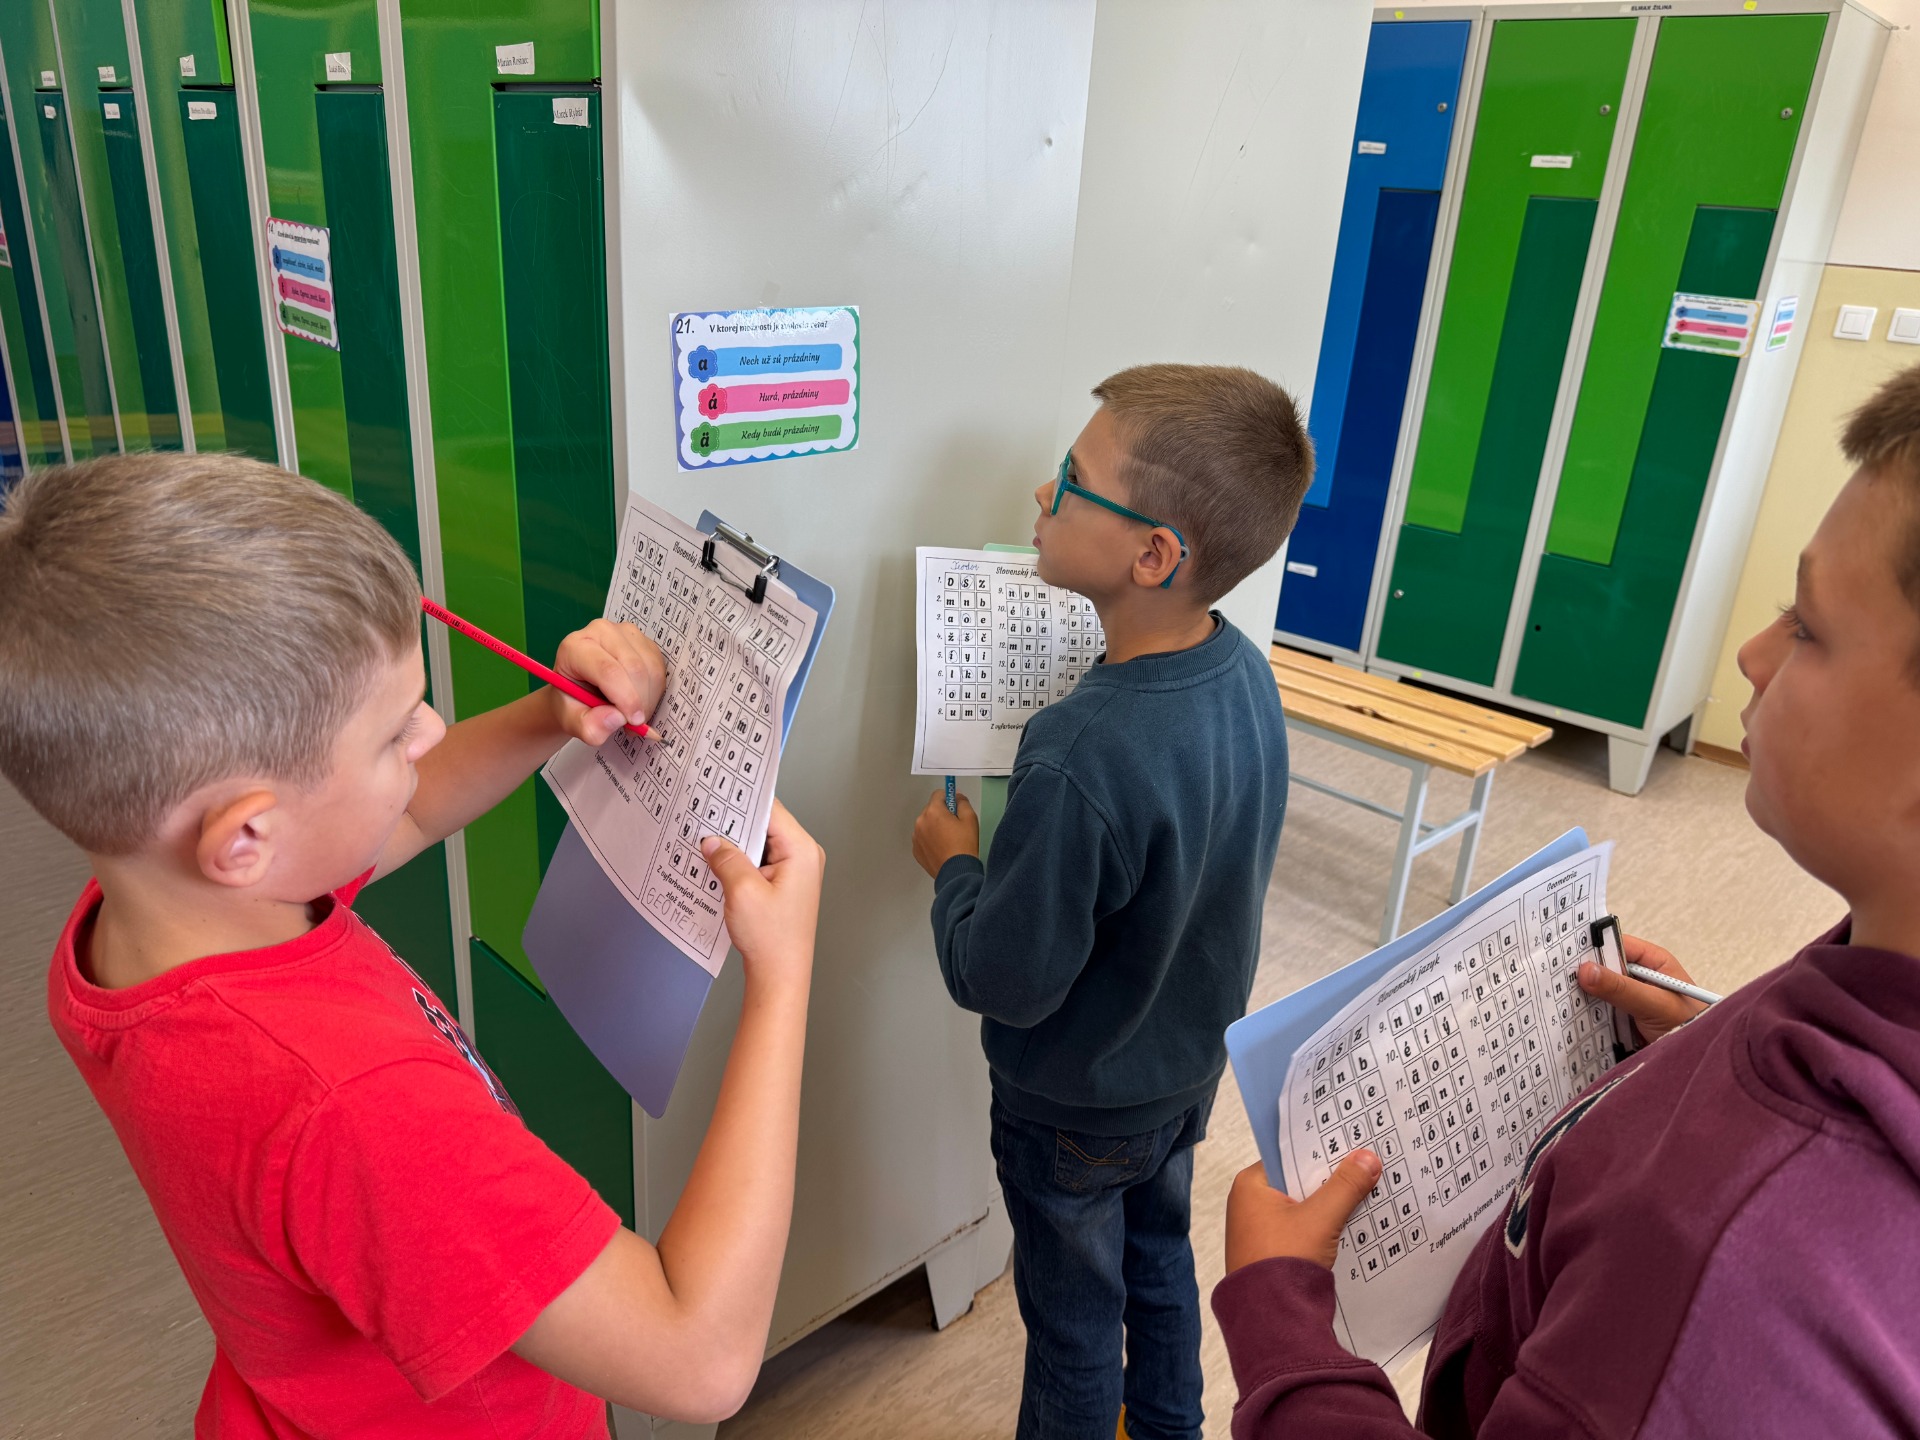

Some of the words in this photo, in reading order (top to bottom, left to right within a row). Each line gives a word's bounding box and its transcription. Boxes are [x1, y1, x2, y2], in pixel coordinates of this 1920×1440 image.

[676, 319, 694, 334] 21.
[710, 324, 716, 332] V
[717, 324, 738, 334] ktorej
[698, 358, 708, 371] a
[740, 355, 759, 366] Nech
[762, 355, 770, 365] už
[773, 354, 781, 363] sú
[783, 352, 820, 366] prázdniny
[708, 392, 717, 410] á
[759, 392, 780, 402] Hurá,
[782, 389, 819, 402] prázdniny
[700, 432, 709, 447] ä
[741, 429, 760, 440] Kedy
[763, 427, 781, 438] budú
[783, 424, 820, 438] prázdniny
[996, 566, 1028, 578] Slovenský
[725, 820, 735, 836] j
[1546, 871, 1577, 892] Geometria
[677, 901, 695, 917] slovo:
[693, 898, 718, 917] písmen
[1433, 992, 1444, 1005] m
[1436, 1156, 1443, 1169] b
[1461, 1172, 1471, 1186] m
[1380, 1217, 1389, 1230] u
[1402, 1203, 1411, 1216] a
[1368, 1258, 1377, 1271] u
[1388, 1243, 1401, 1257] m
